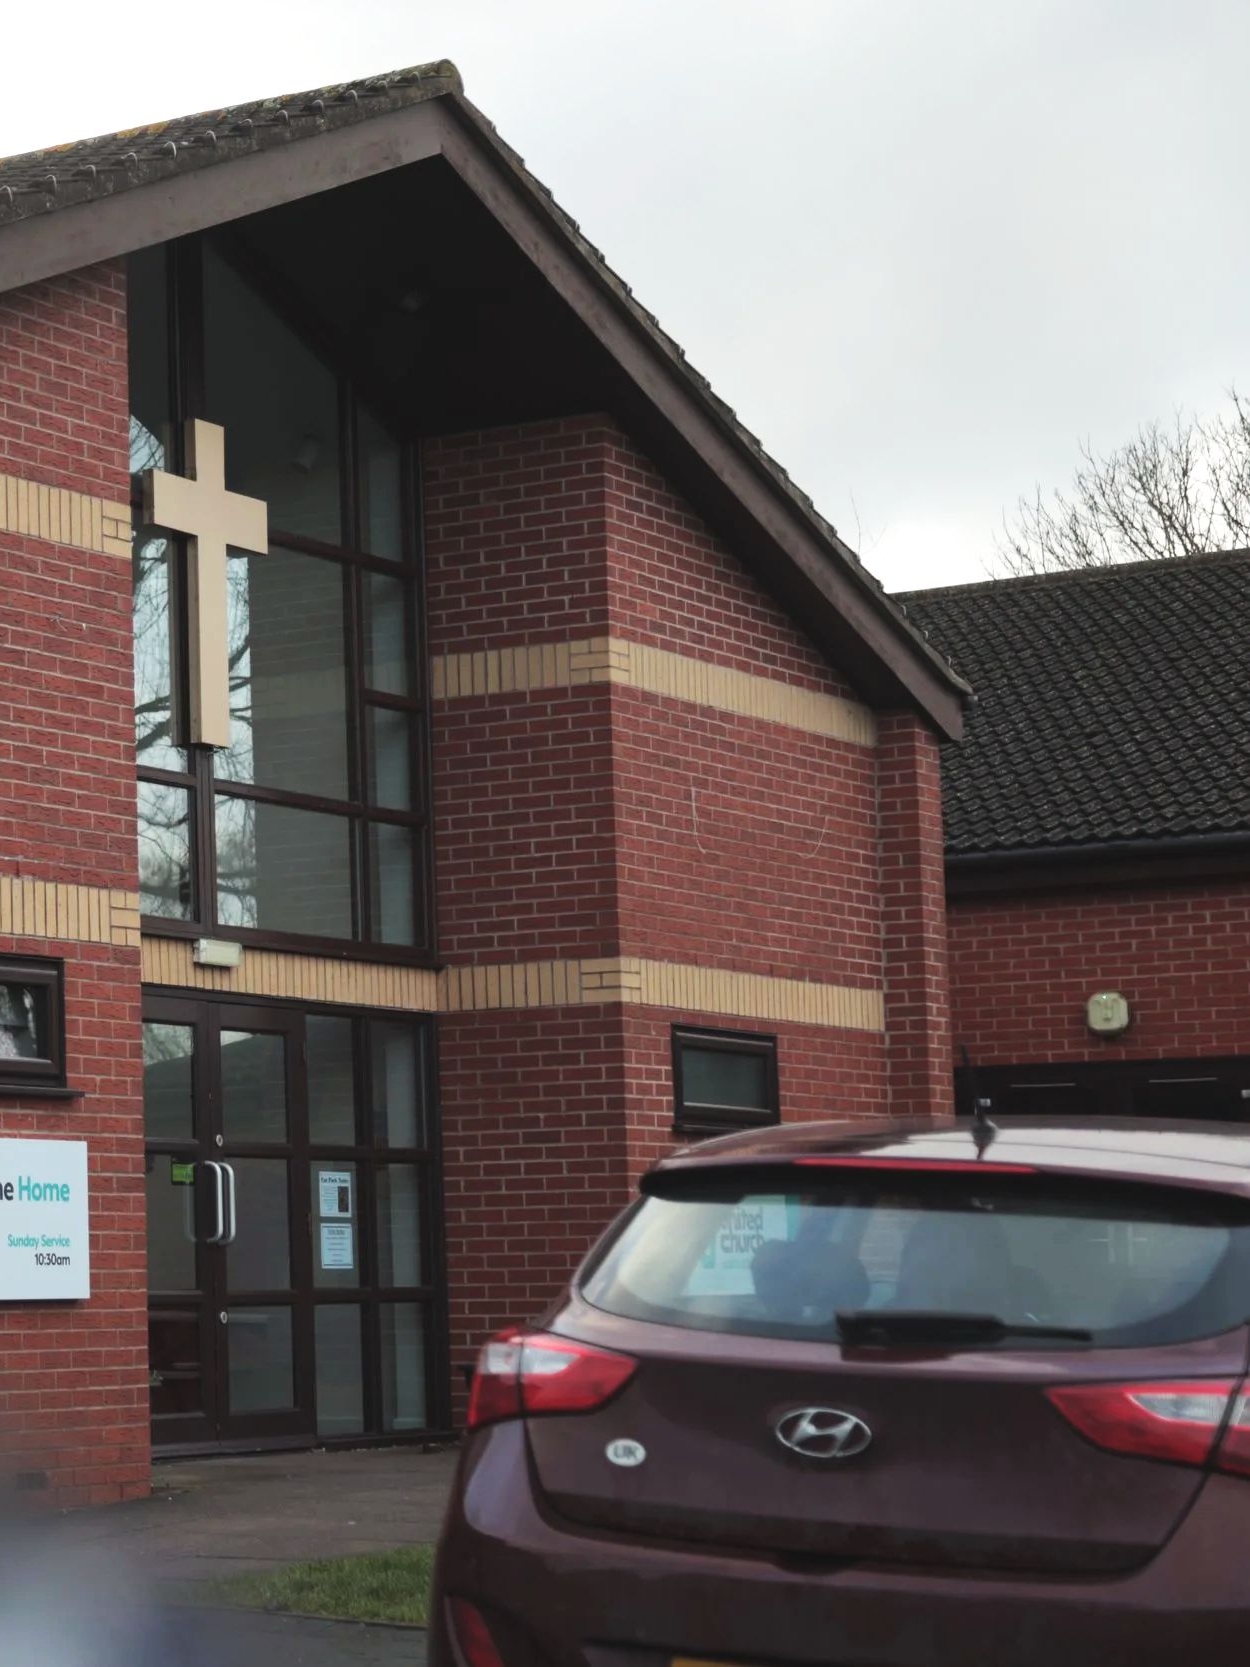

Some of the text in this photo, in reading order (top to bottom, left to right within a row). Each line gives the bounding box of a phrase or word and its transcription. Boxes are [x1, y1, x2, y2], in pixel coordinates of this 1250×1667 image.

[17, 1175, 70, 1201] Home
[7, 1234, 70, 1249] Sunday Service
[34, 1253, 70, 1266] 10:30am
